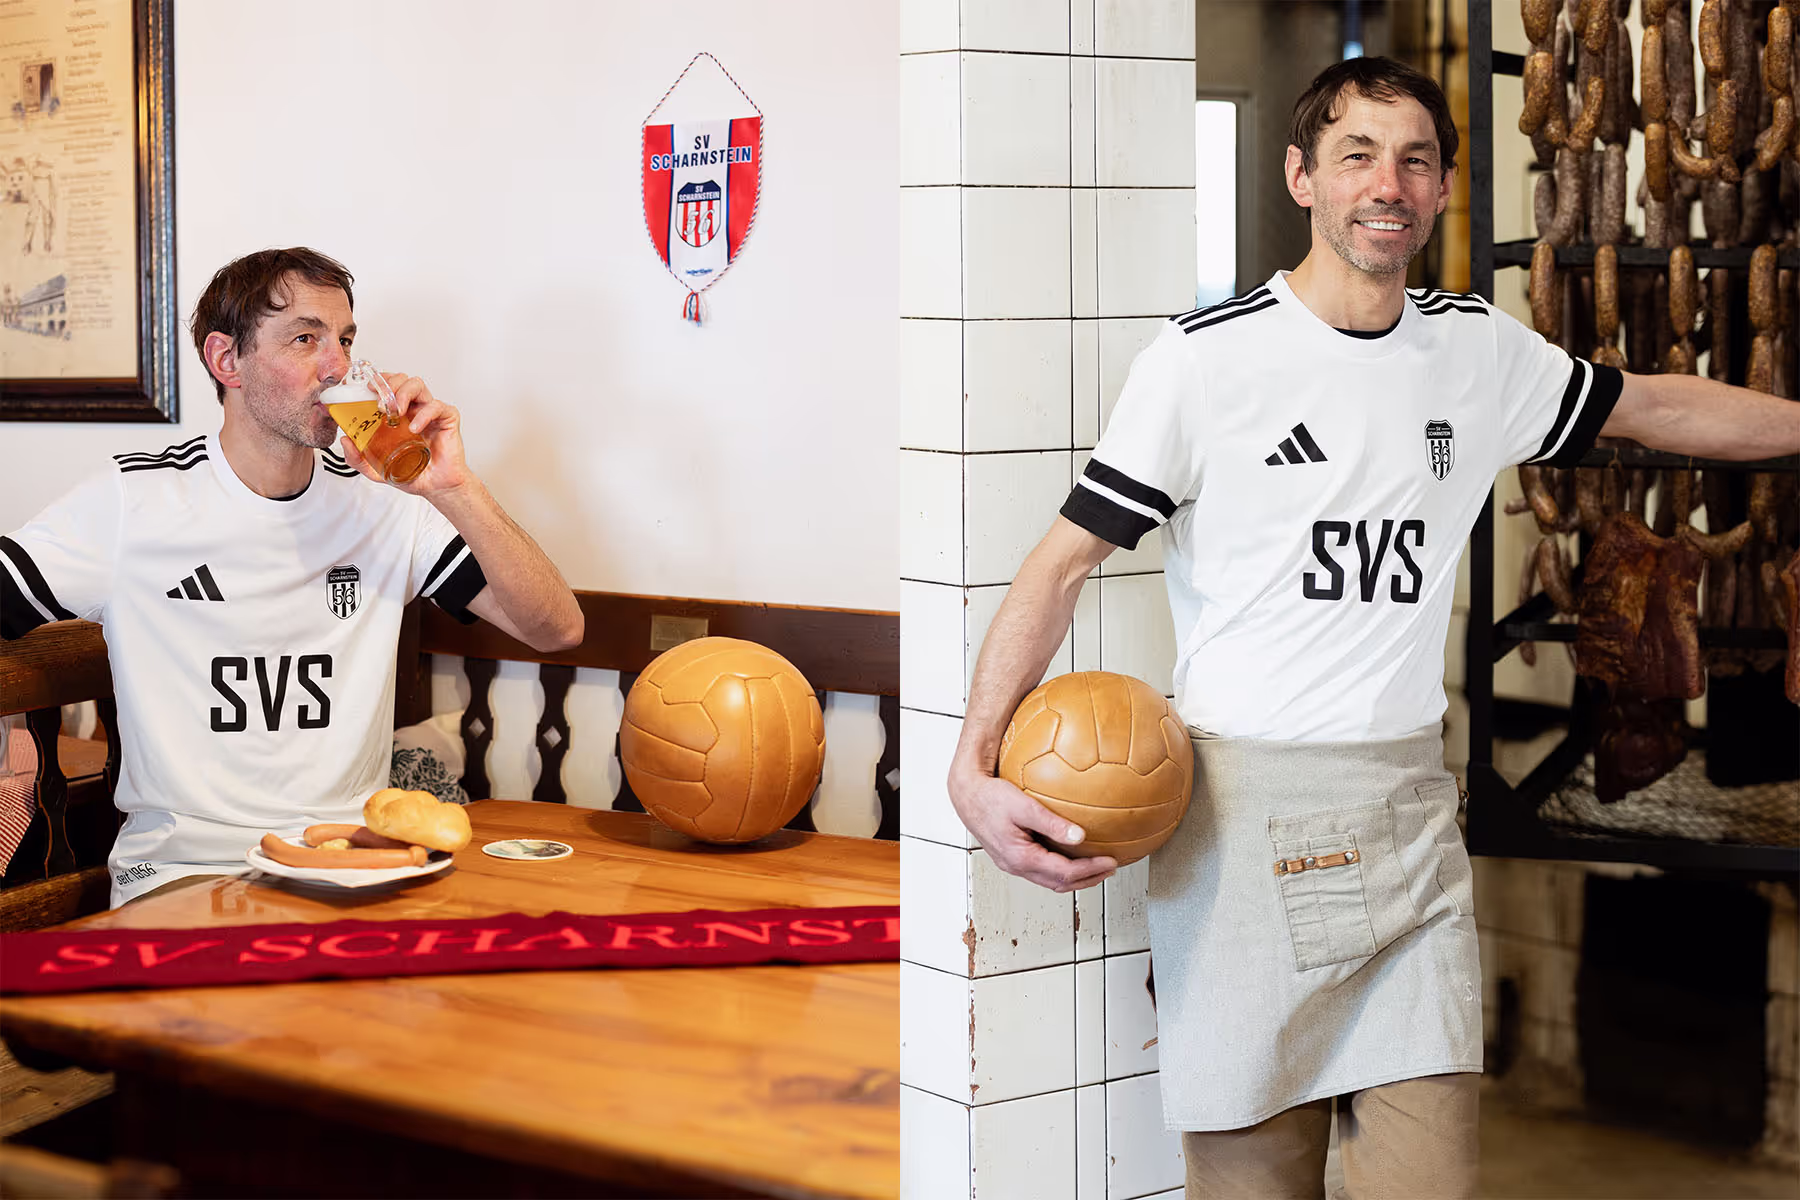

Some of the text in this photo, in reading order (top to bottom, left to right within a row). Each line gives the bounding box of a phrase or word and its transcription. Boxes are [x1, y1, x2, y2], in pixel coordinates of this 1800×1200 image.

[694, 134, 710, 150] SV
[651, 147, 752, 170] SCHARNSTEIN
[678, 191, 720, 203] SCHARNSTEIN
[695, 185, 704, 193] SV
[1432, 445, 1450, 464] 56
[1303, 519, 1425, 603] SVS
[333, 588, 355, 606] 56
[210, 654, 333, 732] SVS
[116, 862, 157, 886] seit 1956
[39, 916, 900, 975] SV SCHARNST
